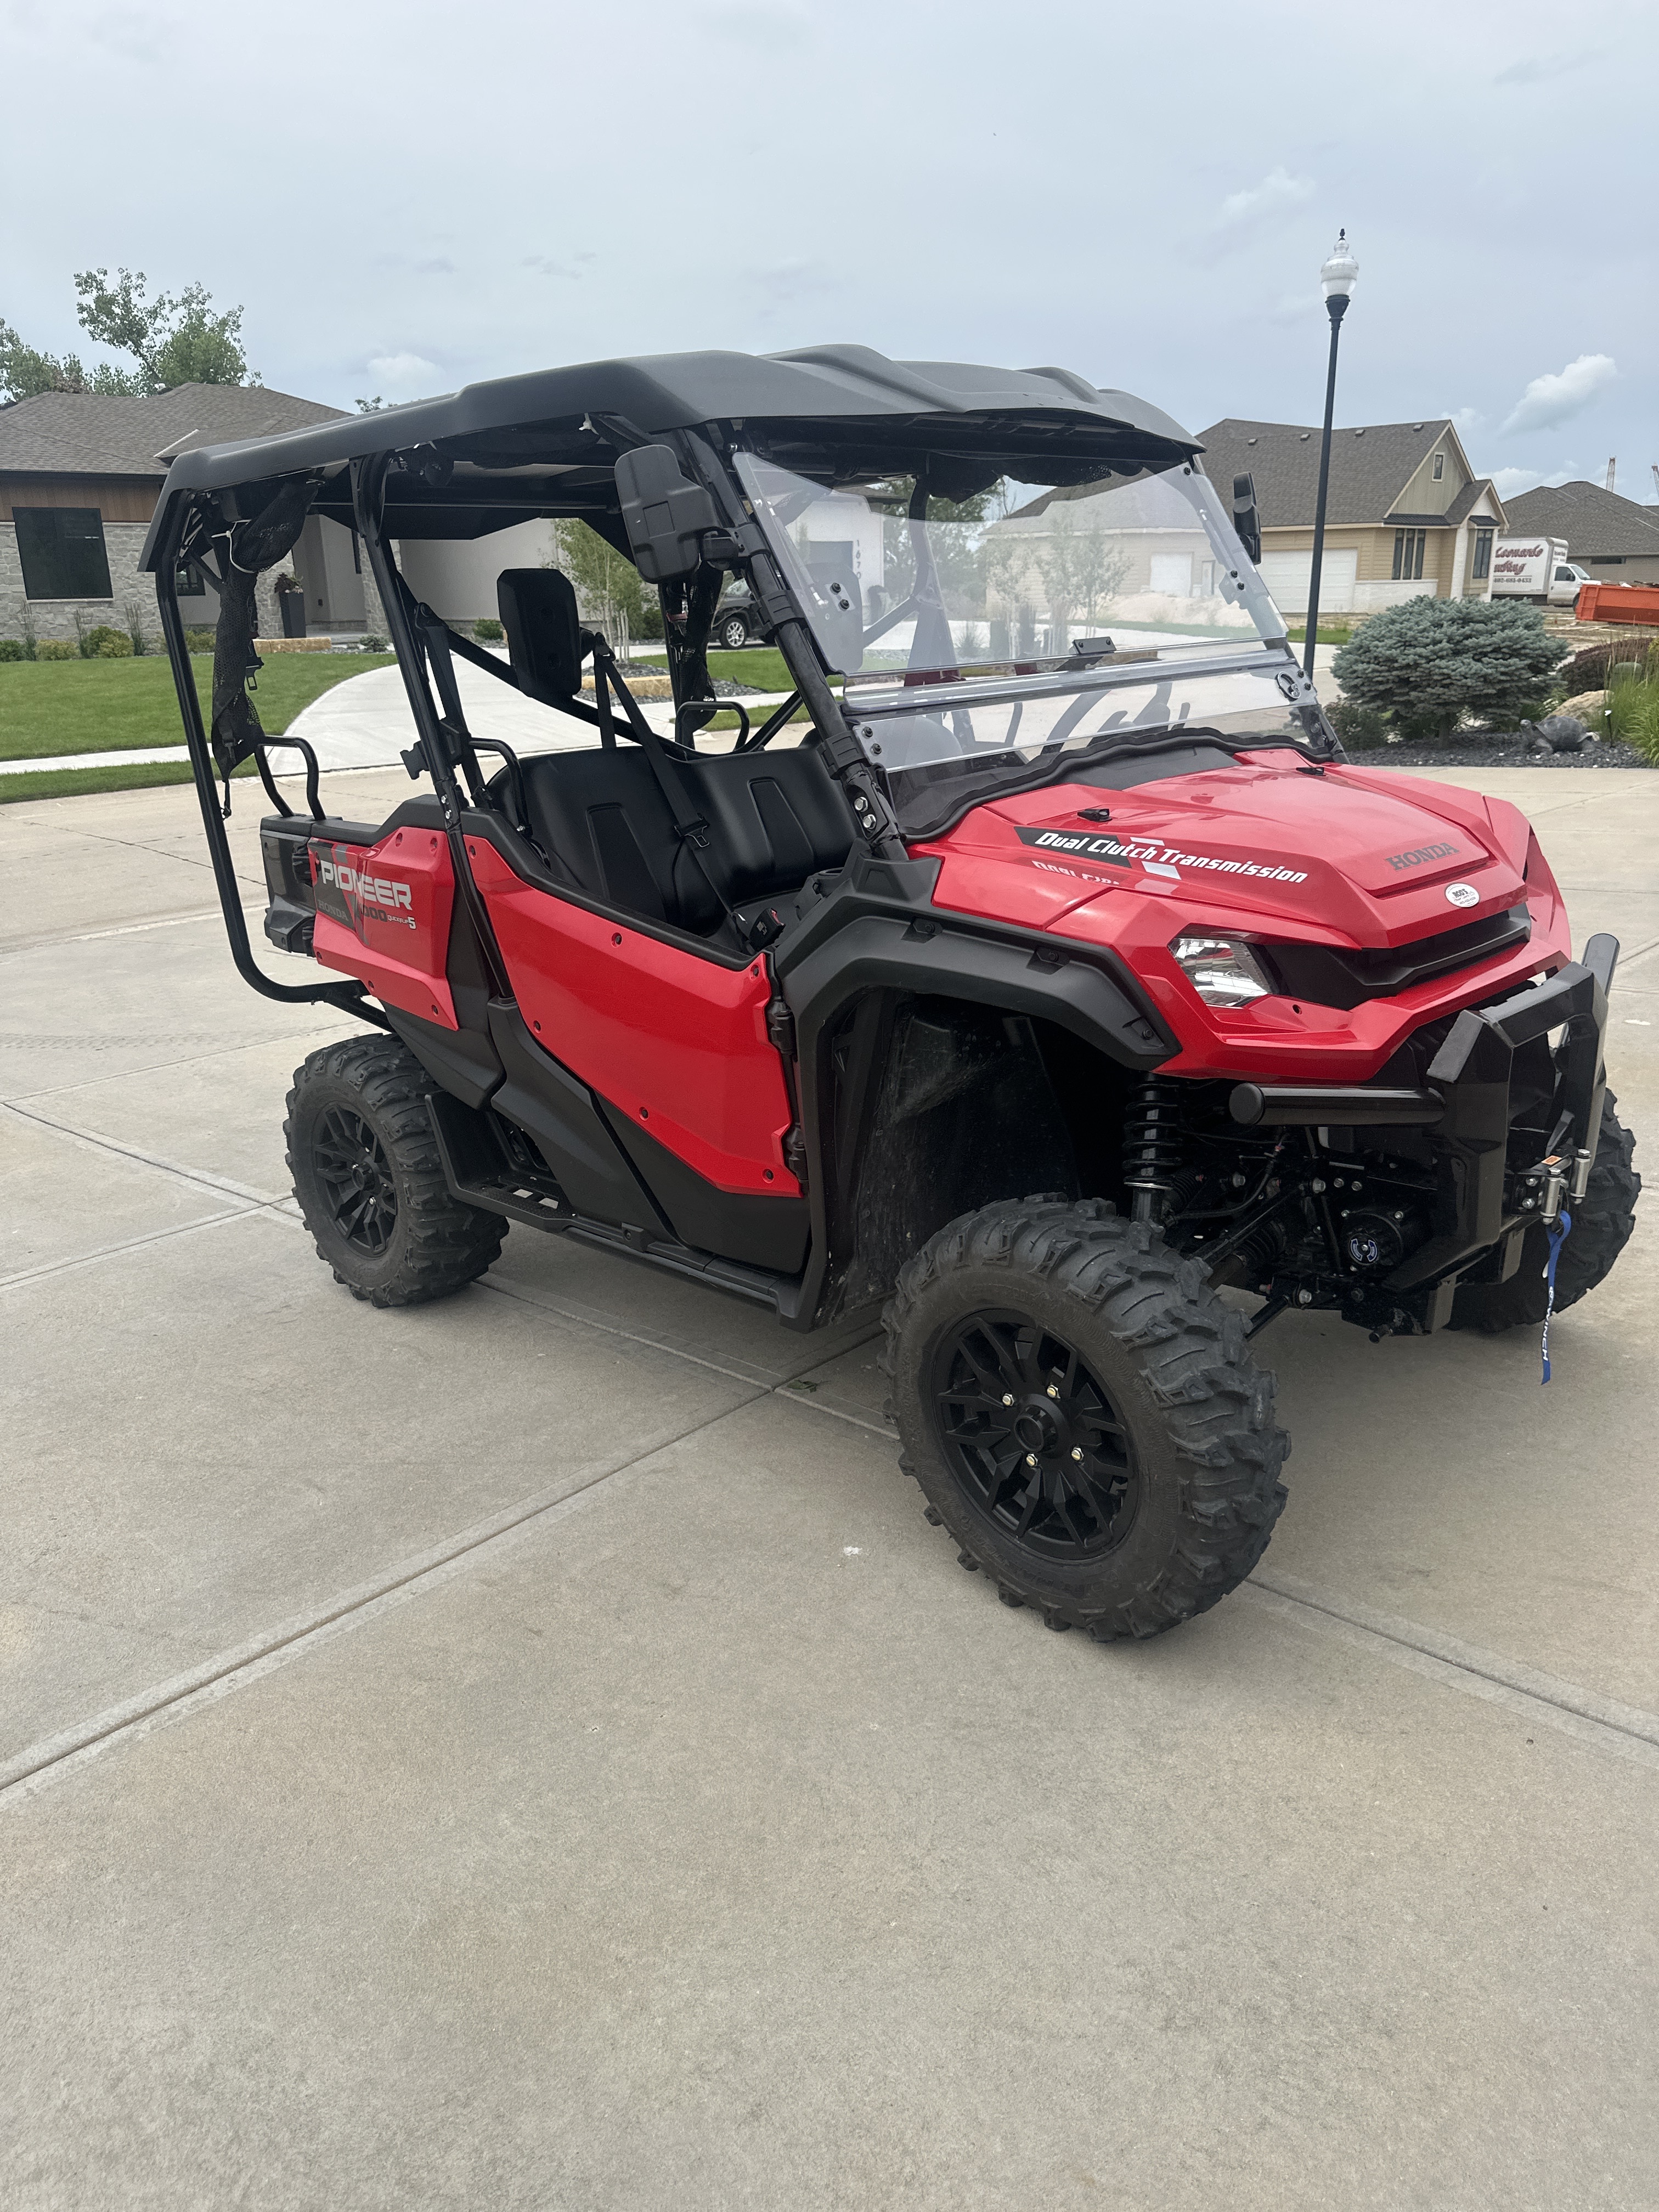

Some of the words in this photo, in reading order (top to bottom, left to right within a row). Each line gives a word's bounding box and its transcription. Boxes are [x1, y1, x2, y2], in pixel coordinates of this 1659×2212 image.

[1034, 832, 1086, 850] Dual
[1087, 839, 1158, 860] Clutch
[1158, 848, 1308, 883] Transmission
[1385, 843, 1460, 871] HONDA
[321, 860, 413, 911] PIONEER
[318, 900, 348, 921] HONDA
